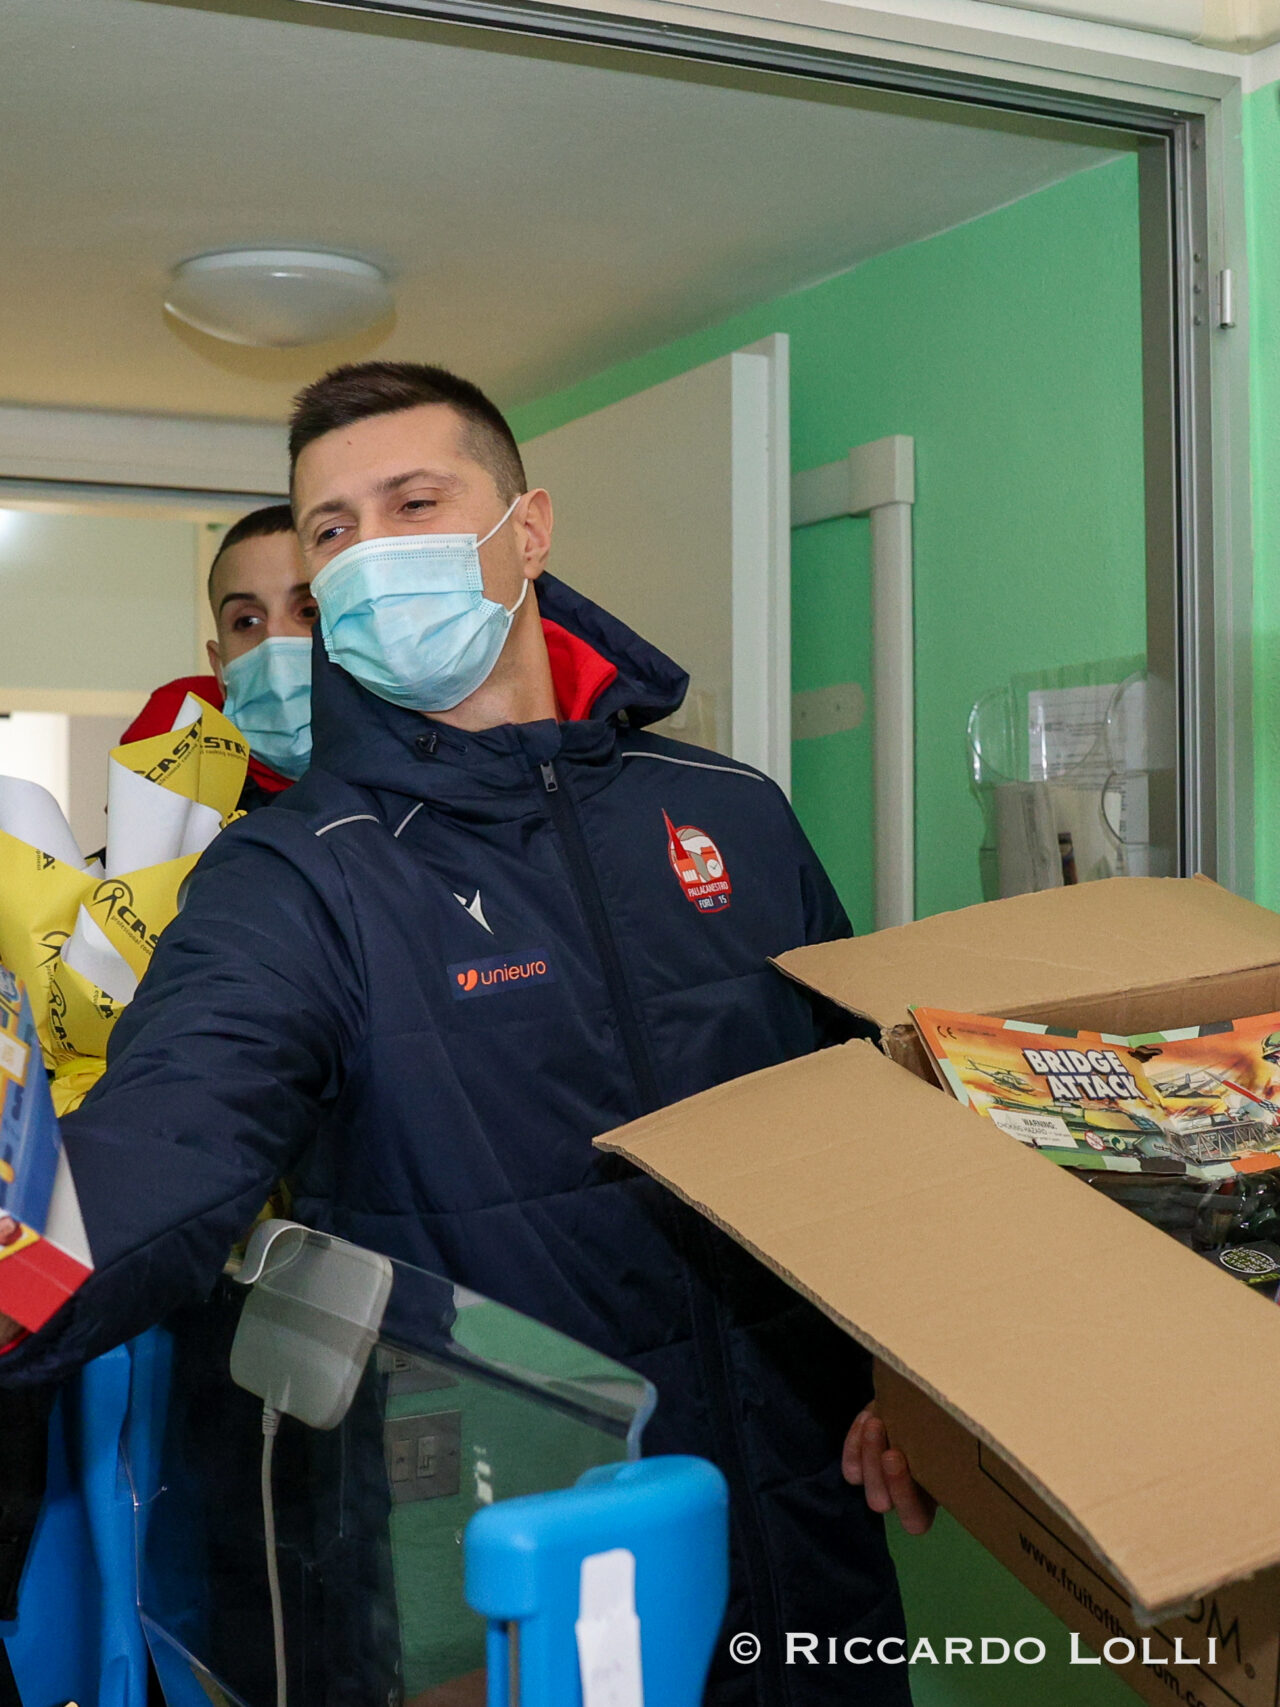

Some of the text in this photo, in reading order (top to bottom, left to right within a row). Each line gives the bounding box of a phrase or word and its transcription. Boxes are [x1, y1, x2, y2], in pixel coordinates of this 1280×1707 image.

[201, 736, 247, 757] STA
[718, 894, 728, 904] 15
[117, 905, 160, 950] CAS
[481, 960, 547, 985] unieuro
[1022, 1048, 1129, 1075] BRIDGE
[1046, 1074, 1149, 1101] ATTACK
